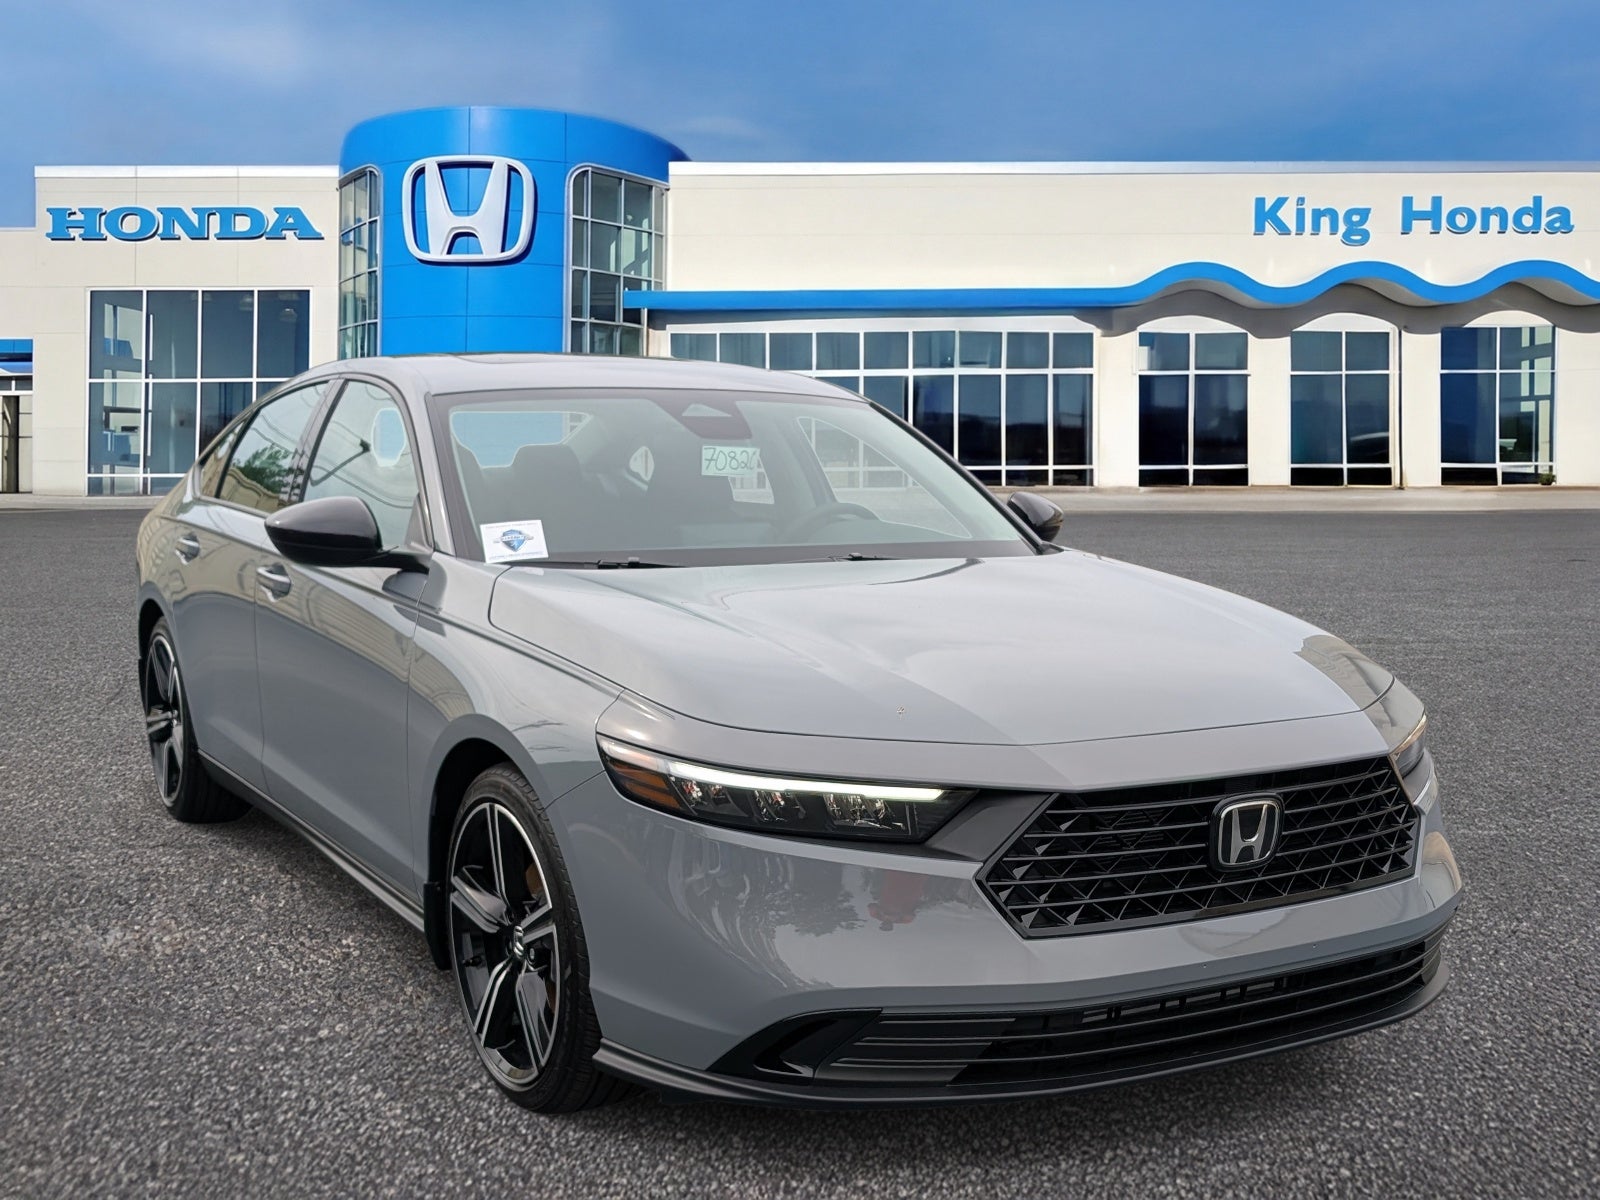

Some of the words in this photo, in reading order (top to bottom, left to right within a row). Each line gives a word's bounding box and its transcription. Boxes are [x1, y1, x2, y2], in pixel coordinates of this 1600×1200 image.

[46, 206, 324, 241] HONDA
[1253, 196, 1371, 246] King
[1400, 195, 1574, 235] Honda
